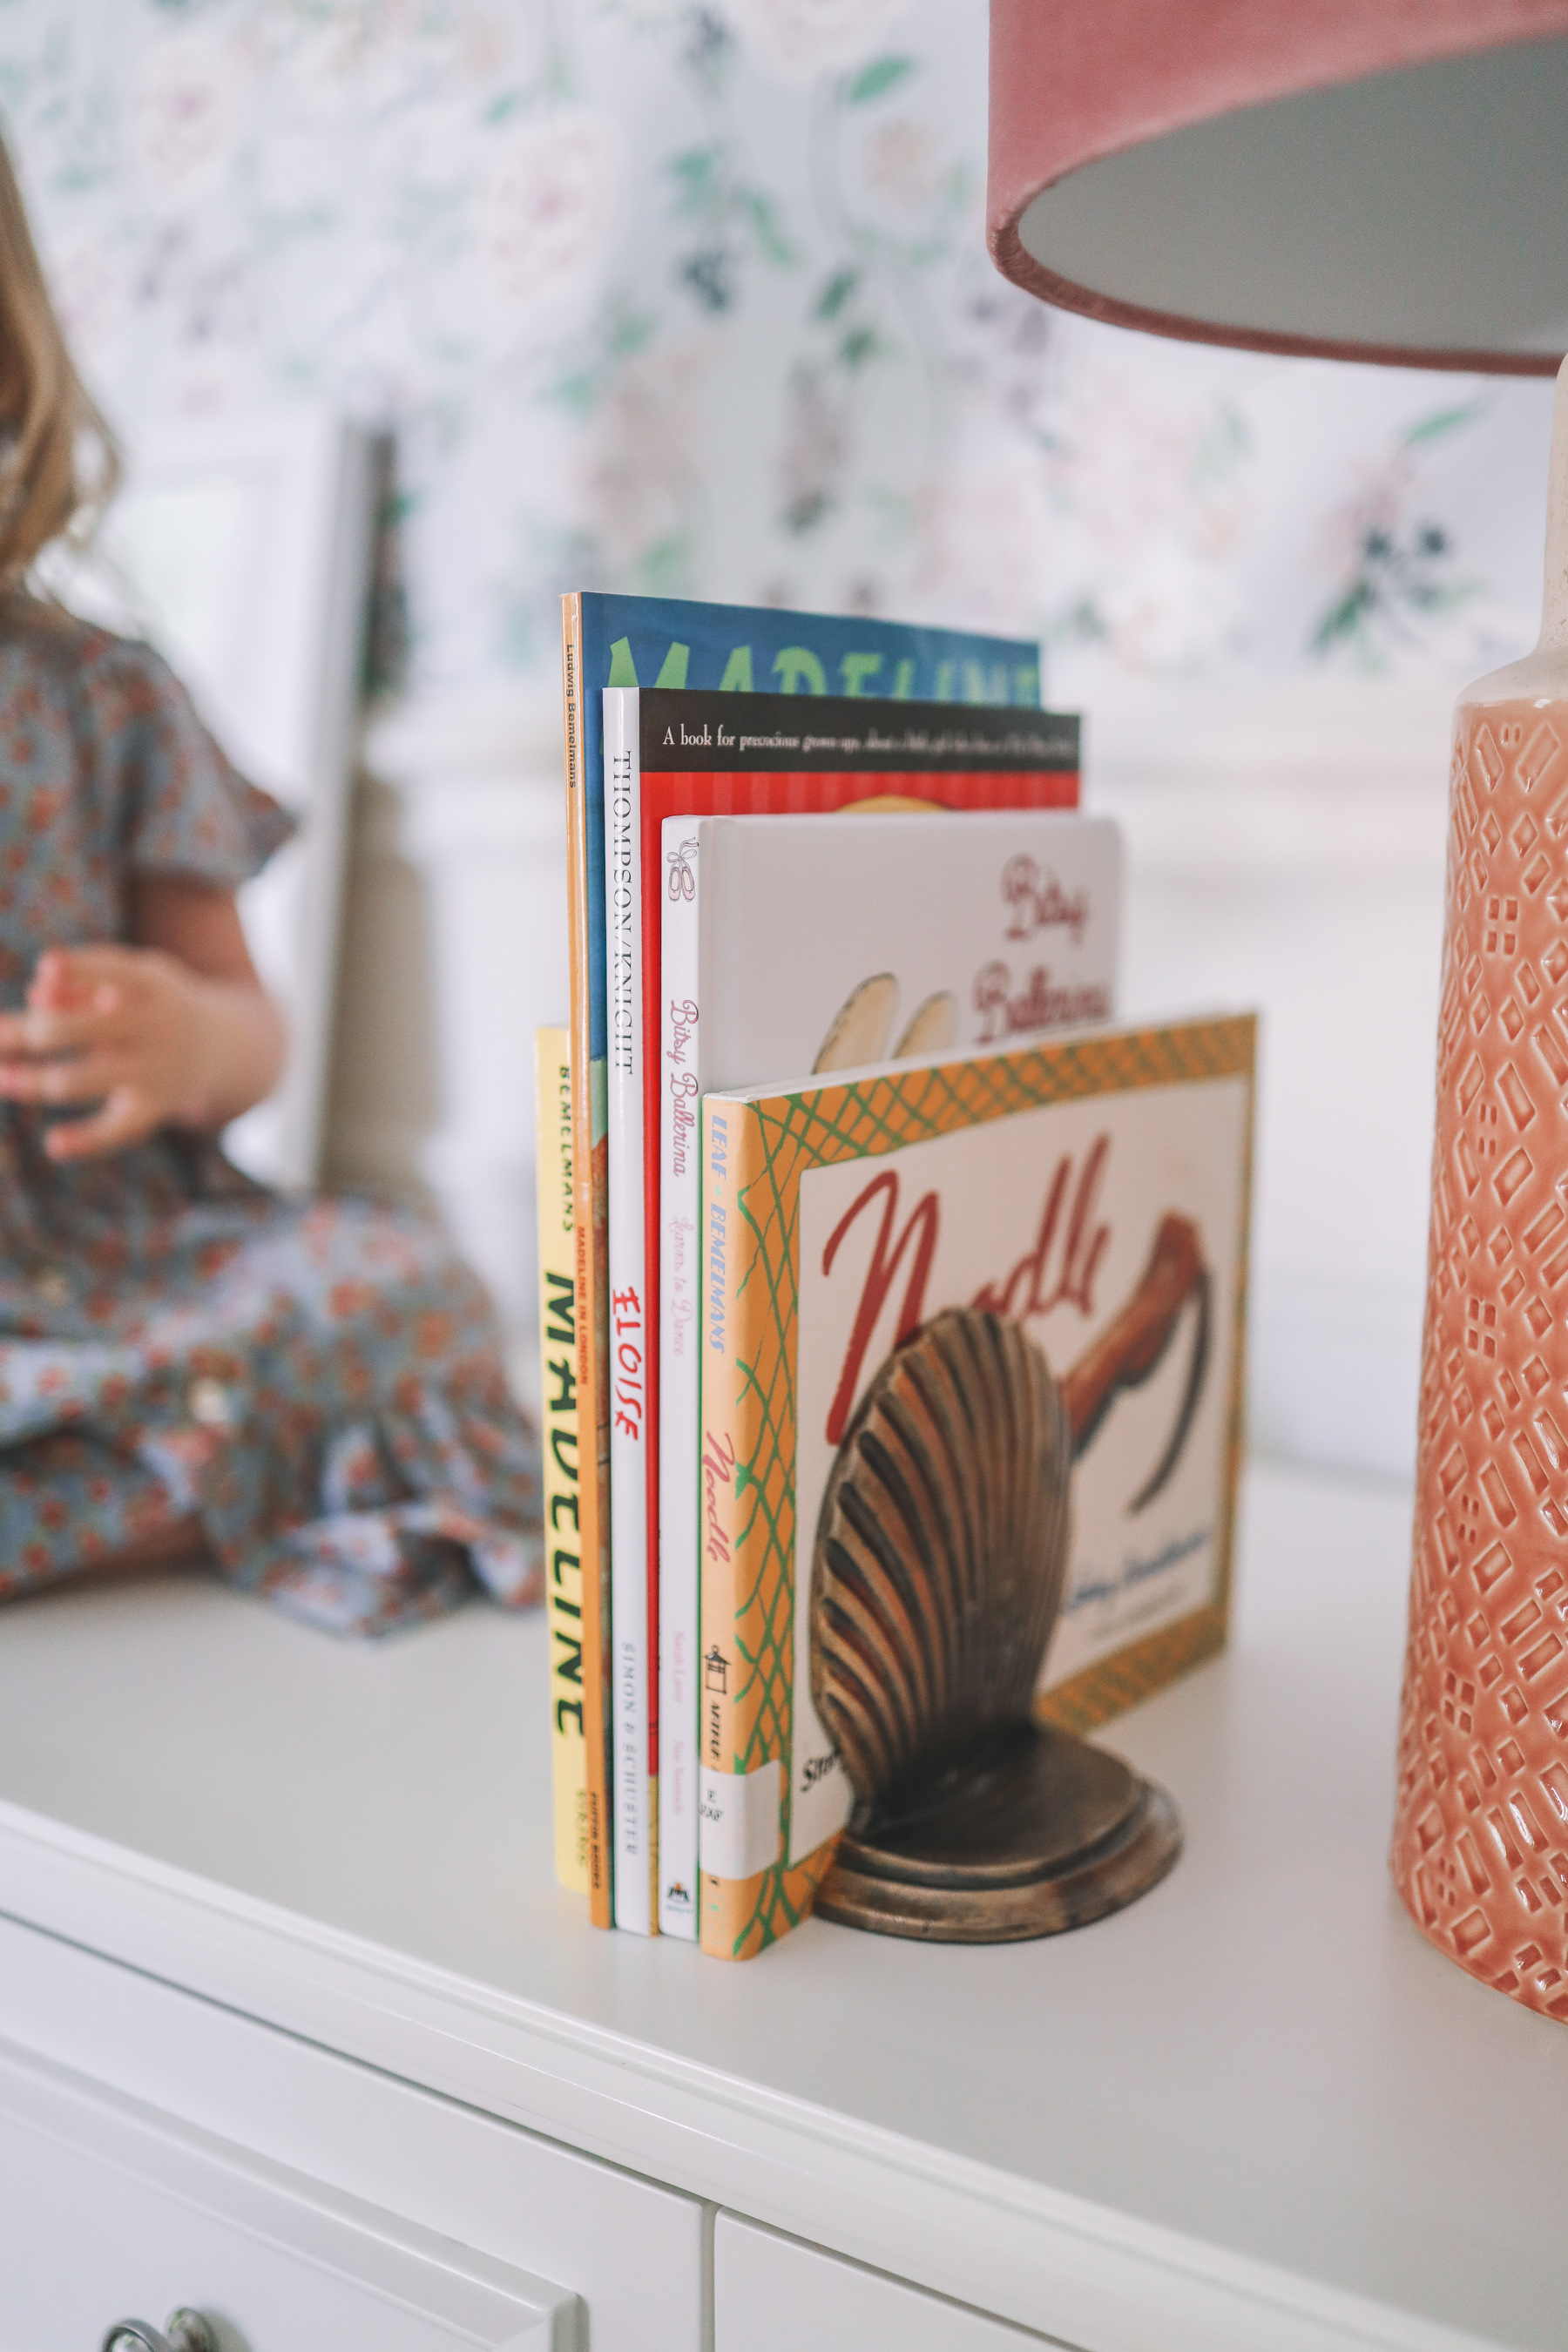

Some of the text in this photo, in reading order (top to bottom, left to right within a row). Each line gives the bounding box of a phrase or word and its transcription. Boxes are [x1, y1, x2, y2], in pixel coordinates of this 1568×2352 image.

[565, 644, 577, 788] Ludwig Bemelmans
[663, 726, 675, 745] A
[680, 723, 713, 747] book
[717, 724, 736, 747] for
[666, 999, 699, 1177] Bitsy Ballerina
[577, 1226, 589, 1385] MADELINE IN LONDON
[667, 1215, 693, 1357] Learns to Dance
[709, 1114, 727, 1355] LEAF BEMELMANS
[821, 1127, 1112, 1448] Ndle
[612, 1285, 643, 1442] ELOISE
[701, 1430, 735, 1563] Noodle
[621, 1640, 636, 1713] SIMON
[622, 1742, 639, 1855] SCHUSTER
[698, 1803, 725, 1822] EAF
